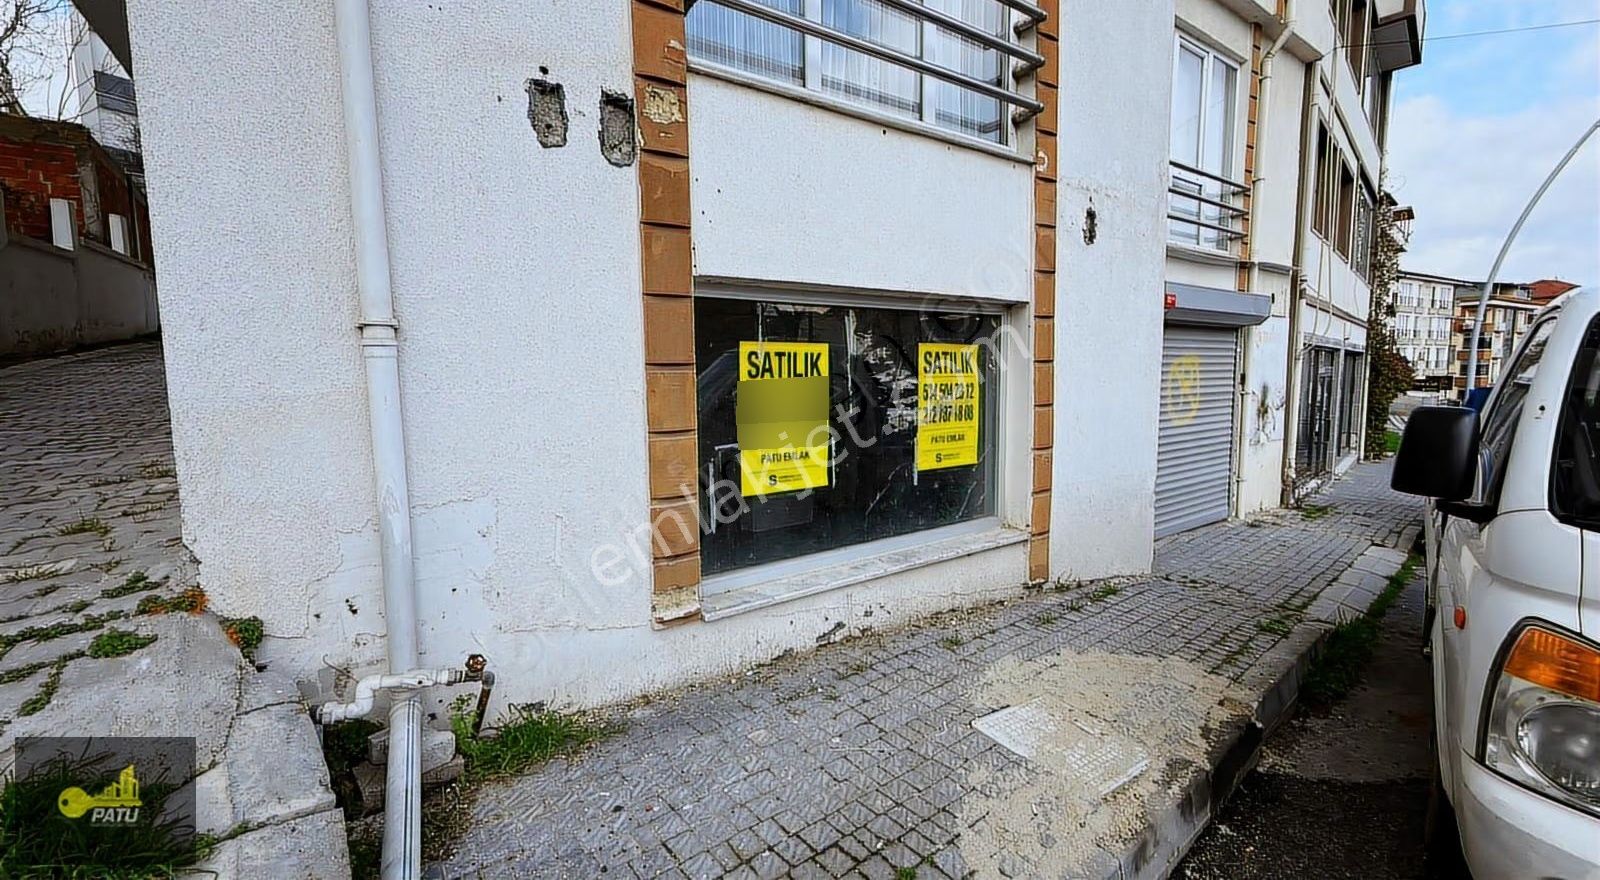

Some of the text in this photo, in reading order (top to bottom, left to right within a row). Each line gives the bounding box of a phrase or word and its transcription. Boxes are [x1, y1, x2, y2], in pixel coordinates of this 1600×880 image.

[747, 350, 822, 379] SATILIK
[923, 351, 974, 374] SATILIK
[761, 453, 782, 464] PATU
